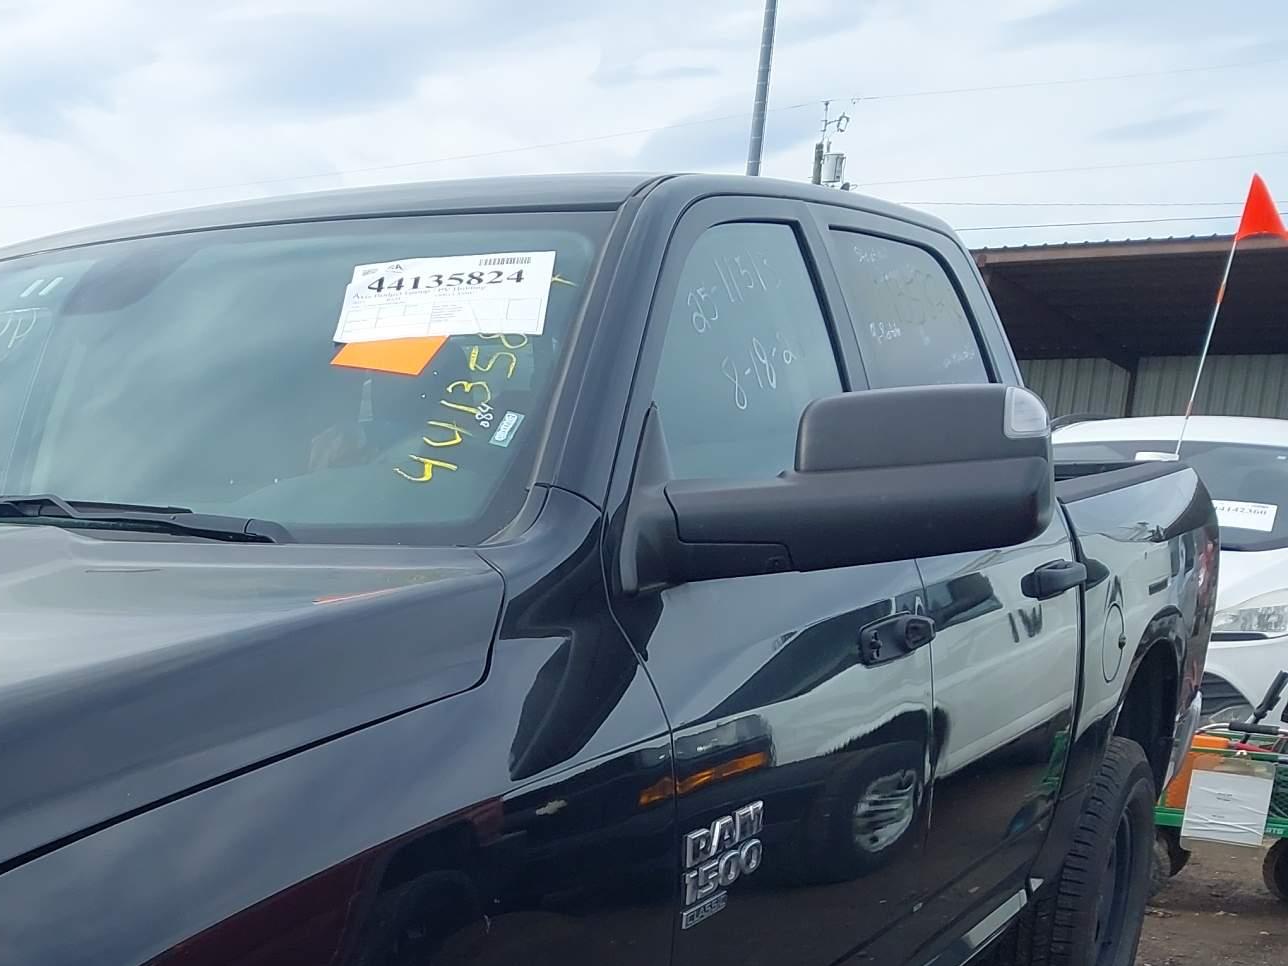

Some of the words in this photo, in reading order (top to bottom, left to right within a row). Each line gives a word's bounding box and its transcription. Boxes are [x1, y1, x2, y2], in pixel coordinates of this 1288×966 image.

[367, 268, 525, 293] 44135824
[683, 800, 764, 868] RAM
[682, 838, 763, 906] 1500
